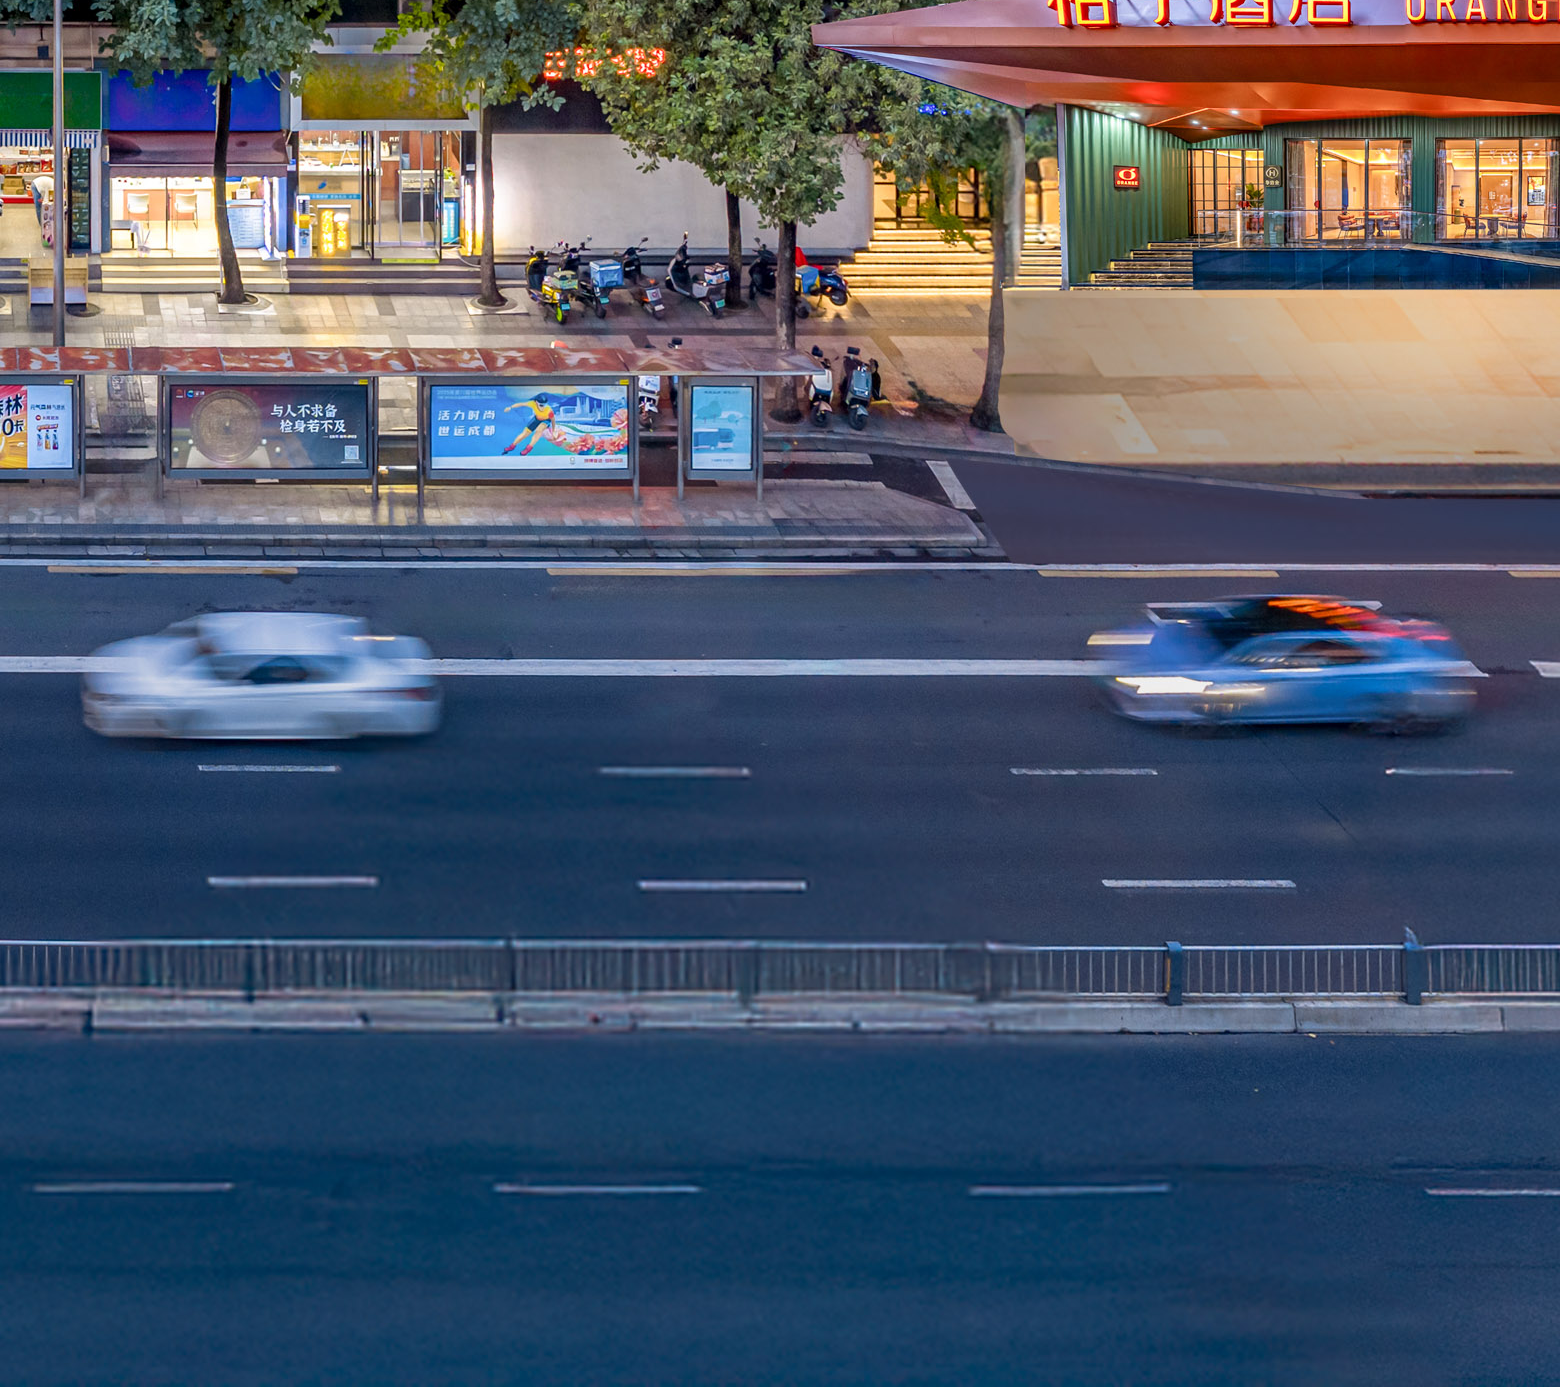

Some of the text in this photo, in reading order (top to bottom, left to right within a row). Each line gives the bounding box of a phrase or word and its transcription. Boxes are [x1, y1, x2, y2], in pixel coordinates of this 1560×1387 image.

[270, 404, 338, 418] 与人不求备
[437, 410, 496, 421] 活力时尚
[438, 425, 496, 437] 世运成都
